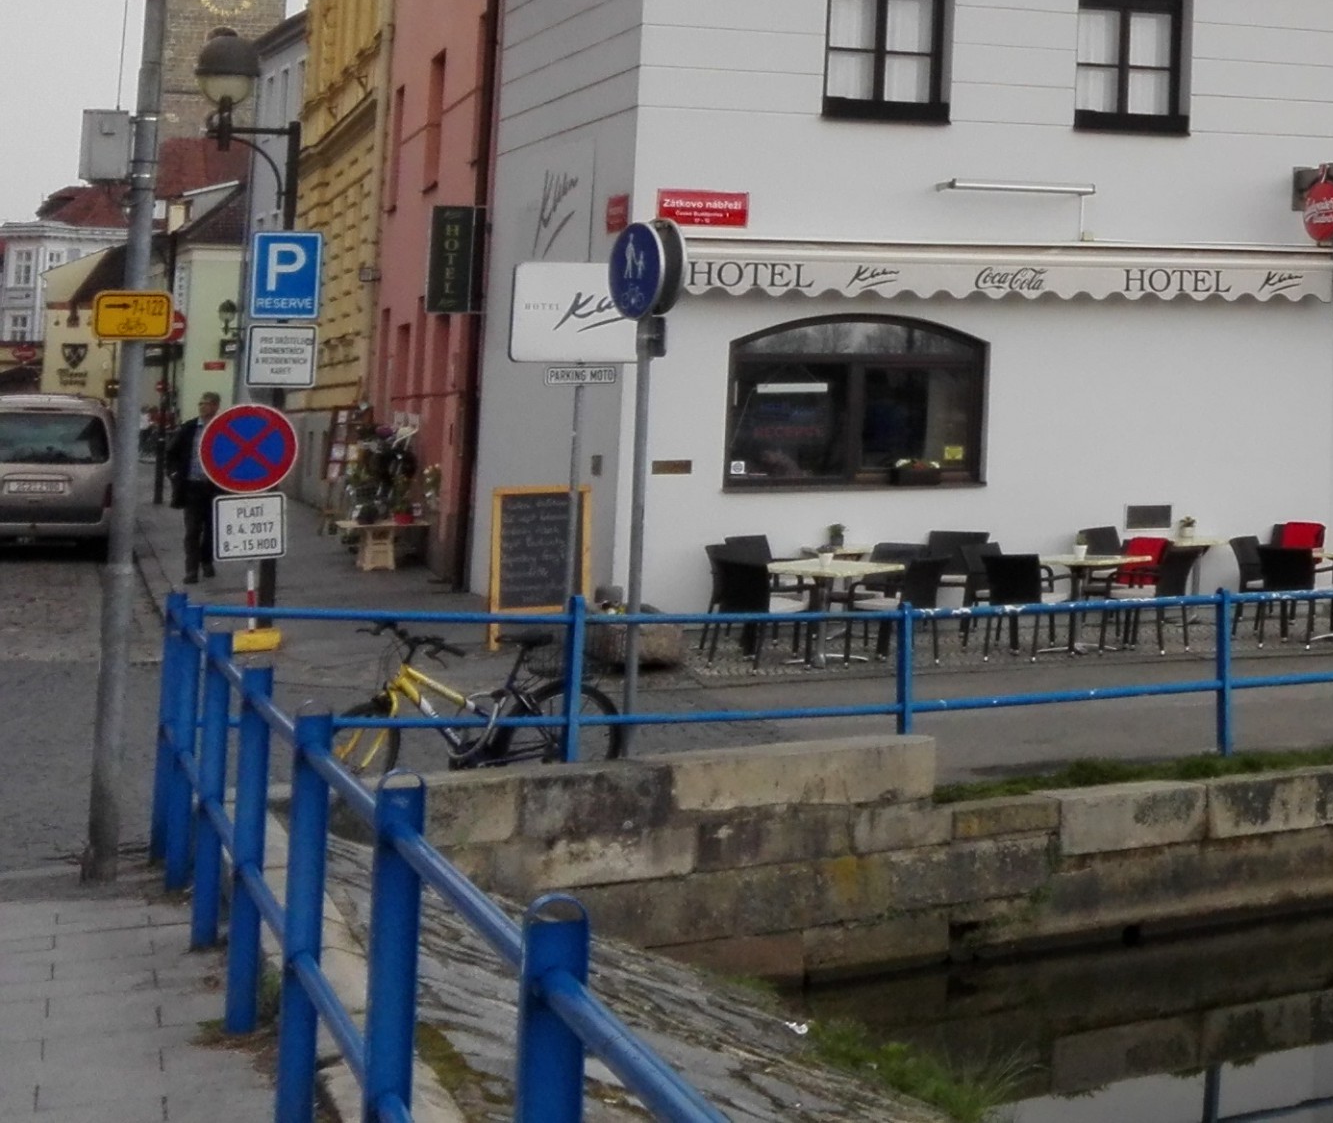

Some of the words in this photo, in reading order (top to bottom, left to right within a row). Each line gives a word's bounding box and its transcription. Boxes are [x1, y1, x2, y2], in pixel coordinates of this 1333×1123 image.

[662, 198, 704, 209] Zátkovo
[705, 199, 742, 211] nábřeží
[443, 224, 460, 294] HOTEL
[266, 242, 307, 292] P
[688, 260, 814, 289] HOTEL
[974, 266, 1049, 291] Coca-Cola
[1123, 268, 1232, 293] HOTEL
[524, 302, 560, 311] HOTEL
[549, 369, 587, 381] PARKING
[590, 369, 614, 381] MOTO
[236, 504, 264, 518] PLATÍ
[250, 522, 274, 534] 2017
[257, 537, 277, 549] HOD
